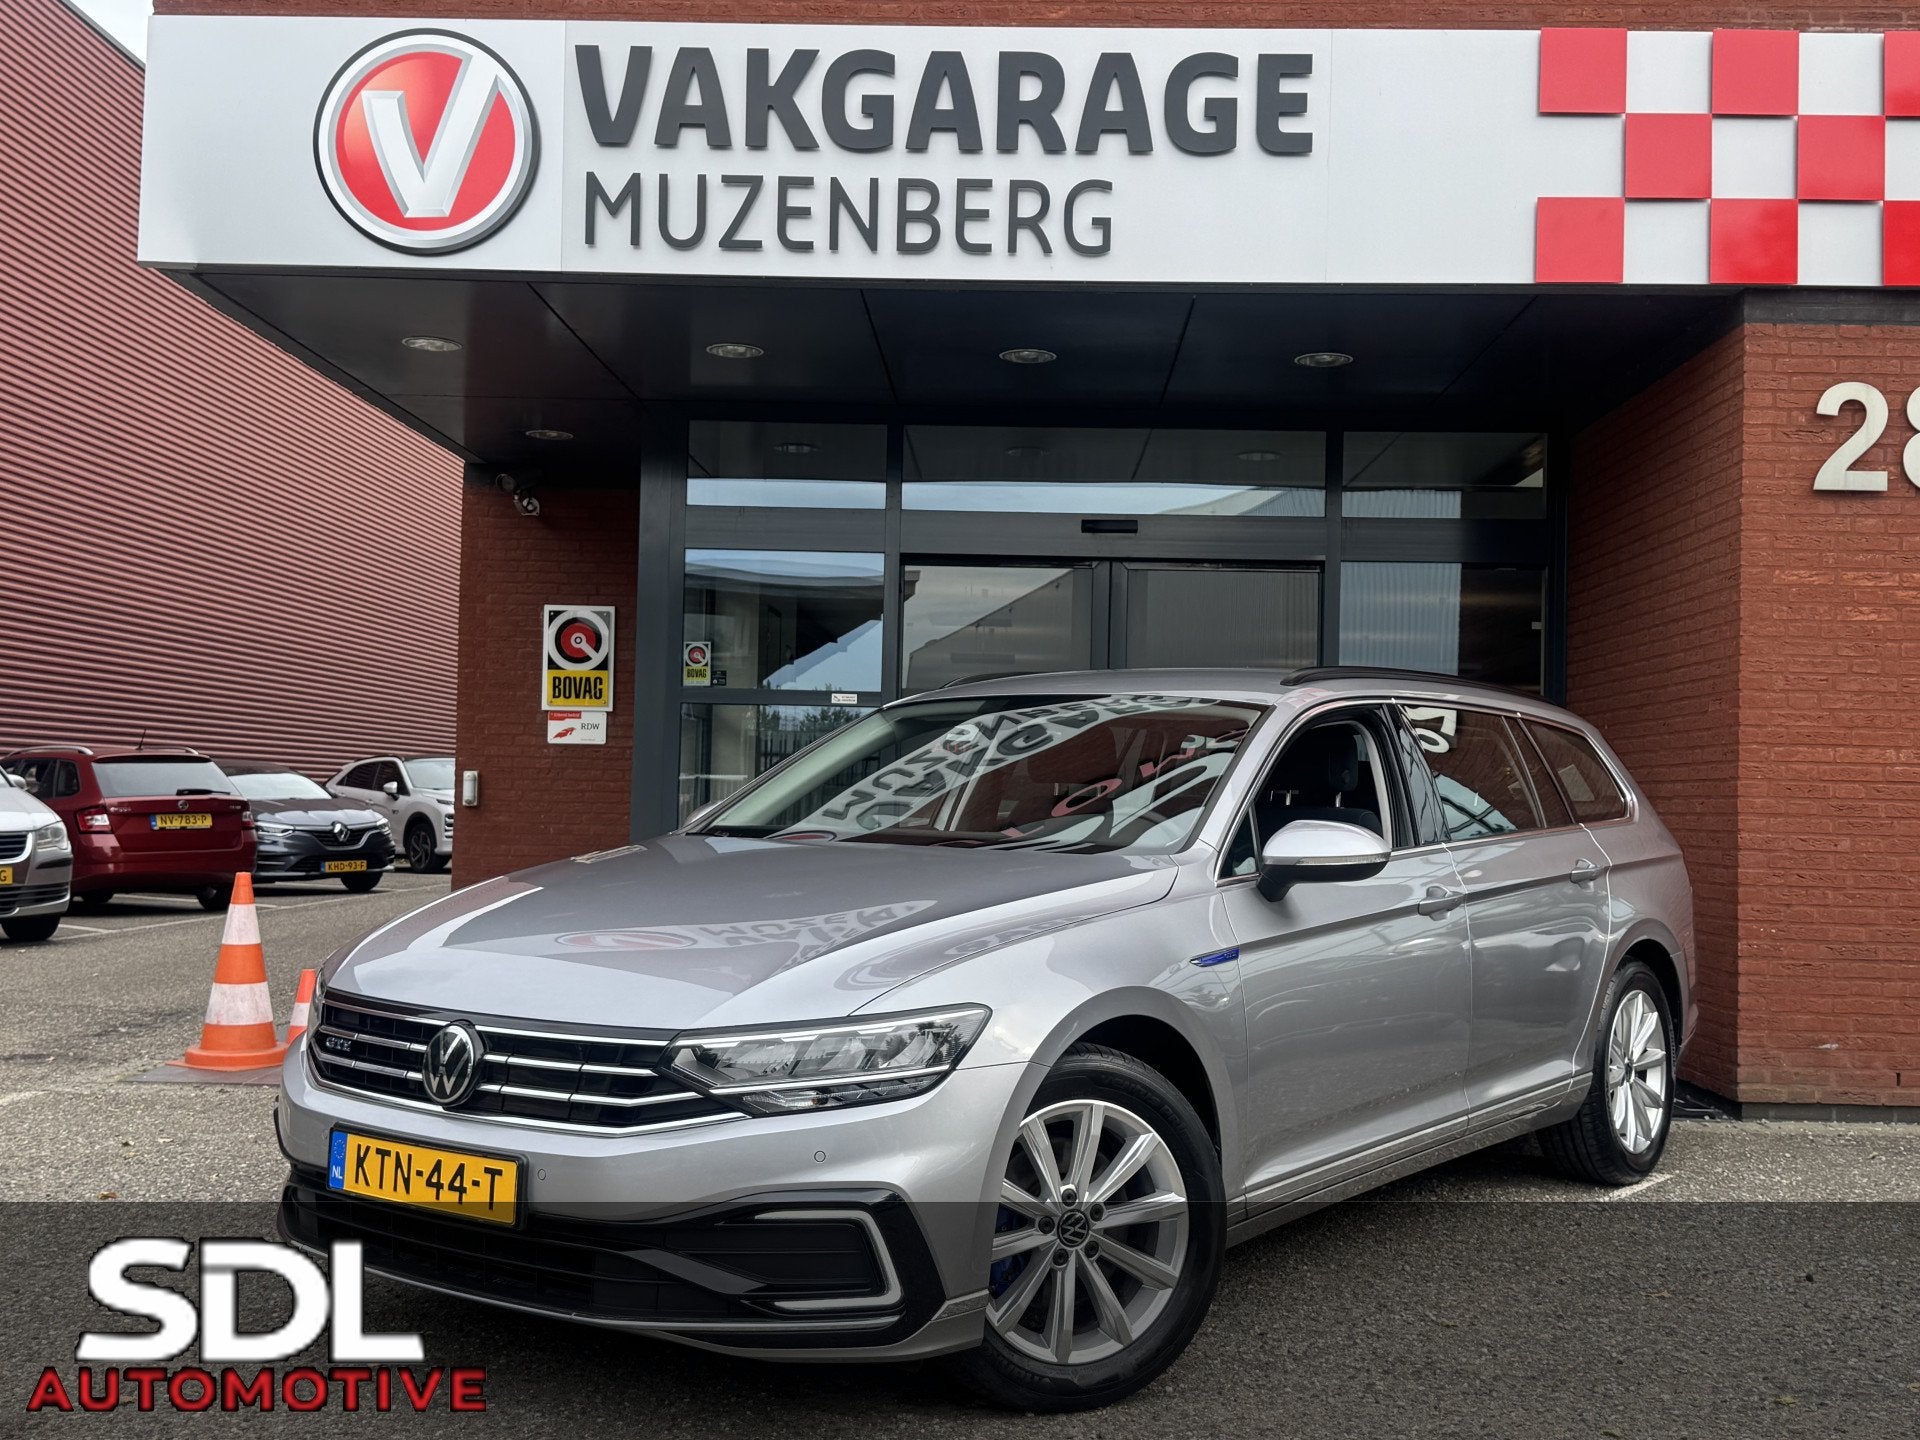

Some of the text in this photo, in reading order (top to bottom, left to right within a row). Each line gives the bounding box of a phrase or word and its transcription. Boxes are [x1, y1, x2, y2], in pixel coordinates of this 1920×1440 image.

[575, 45, 1313, 156] VAKGARAGE
[585, 171, 1113, 255] MUZENBERG
[1813, 381, 1920, 491] 2
[552, 676, 603, 700] BOVAG
[160, 814, 207, 825] NV-783-P
[331, 1165, 343, 1180] NL
[355, 1143, 503, 1211] KTN-44-T
